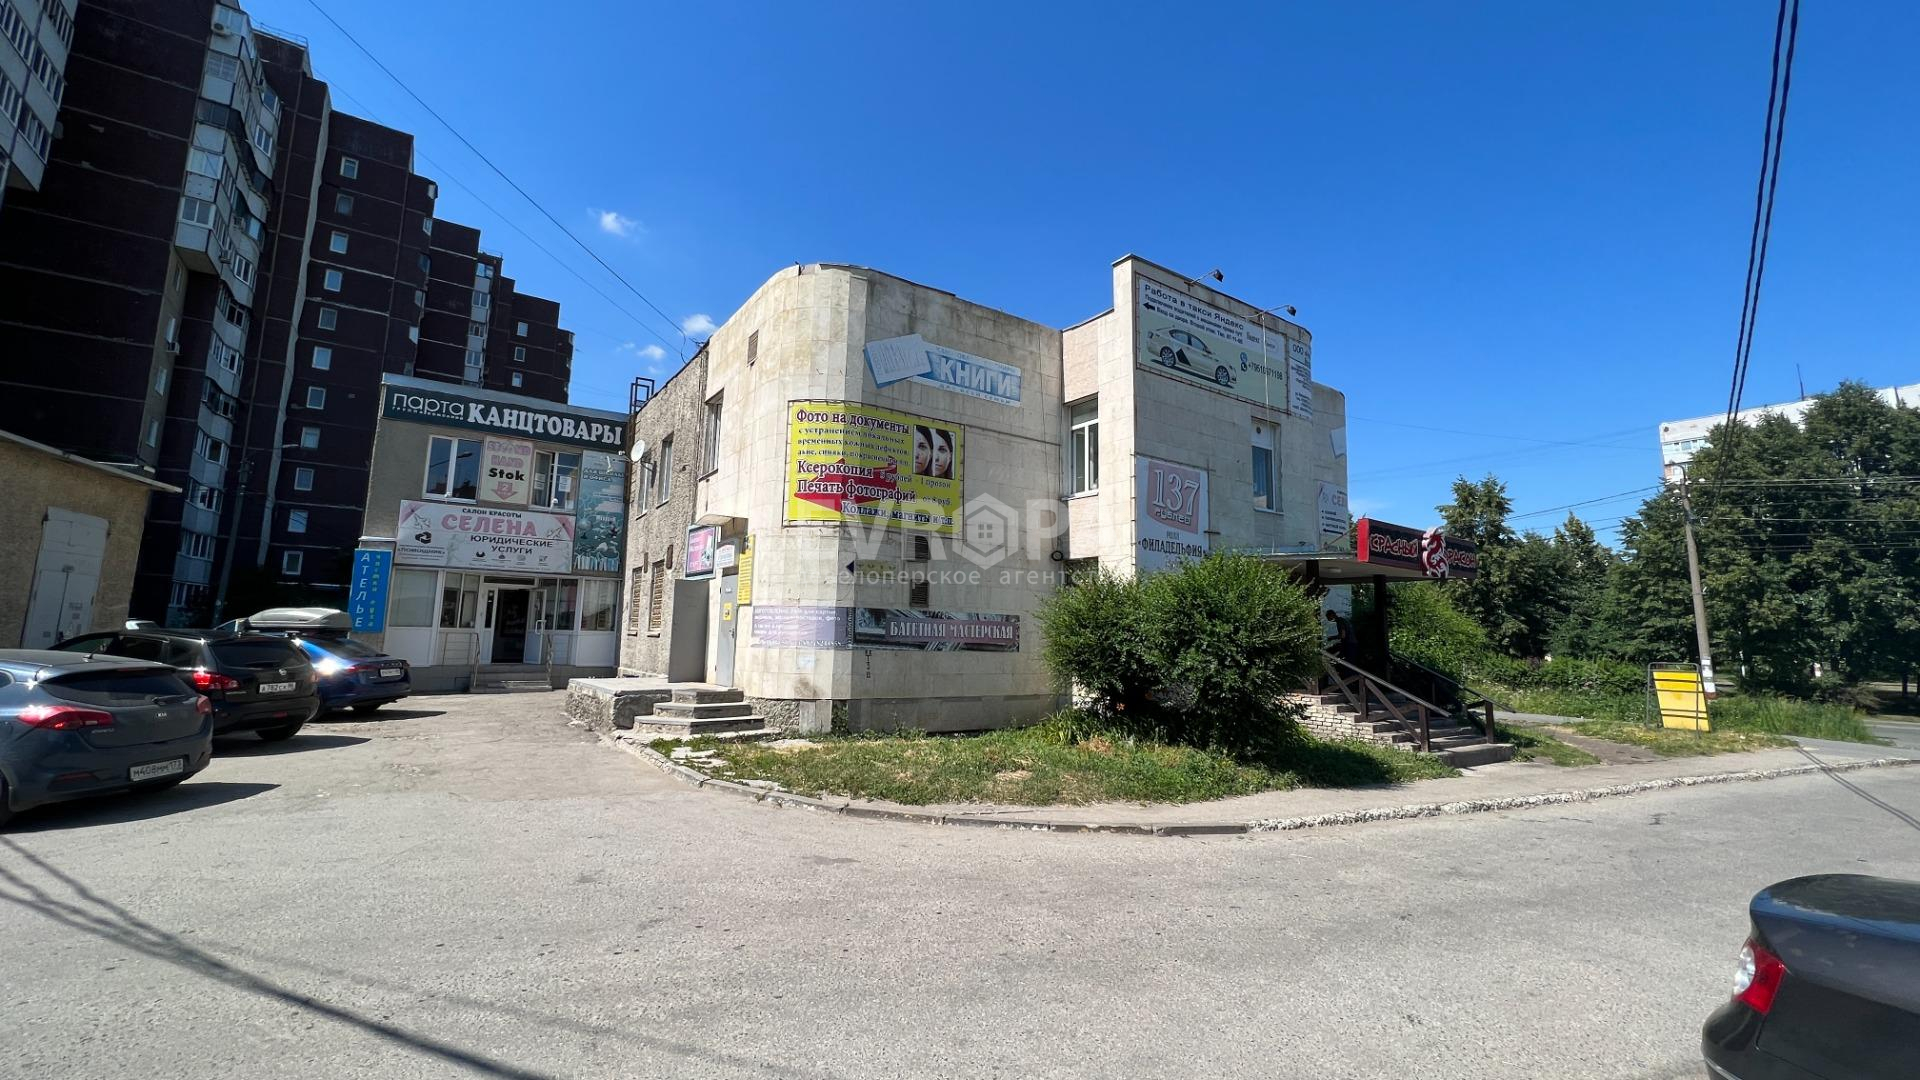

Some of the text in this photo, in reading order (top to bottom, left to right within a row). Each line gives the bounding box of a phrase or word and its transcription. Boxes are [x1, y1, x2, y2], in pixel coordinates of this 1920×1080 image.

[1144, 284, 1178, 304] Работа
[1188, 303, 1212, 318] такси
[1214, 312, 1244, 330] Яндекс
[940, 357, 1011, 397] КНИГИ
[467, 403, 622, 446] КАНЦТОВАРЫ
[796, 409, 910, 434] Фото на документы
[805, 428, 861, 437] устранением
[488, 467, 525, 481] Stok
[797, 460, 873, 478] Ксерокопия
[797, 480, 844, 493] Печать
[846, 479, 917, 505] фотографий
[1152, 469, 1201, 516] 137
[462, 508, 522, 519] САЛОН КРАСОТЫ
[841, 502, 889, 519] Коллажи,
[891, 508, 930, 523] магниты
[440, 513, 538, 537] СЕЛЕНА
[470, 535, 554, 549] ЮРИДИЧЕСКИЕ
[491, 545, 533, 555] УСЛУГИ
[354, 552, 370, 628] АТЕЛЬЕ
[890, 621, 1013, 639] БАГЕТНАЯ МАСТЕРСКАЯ
